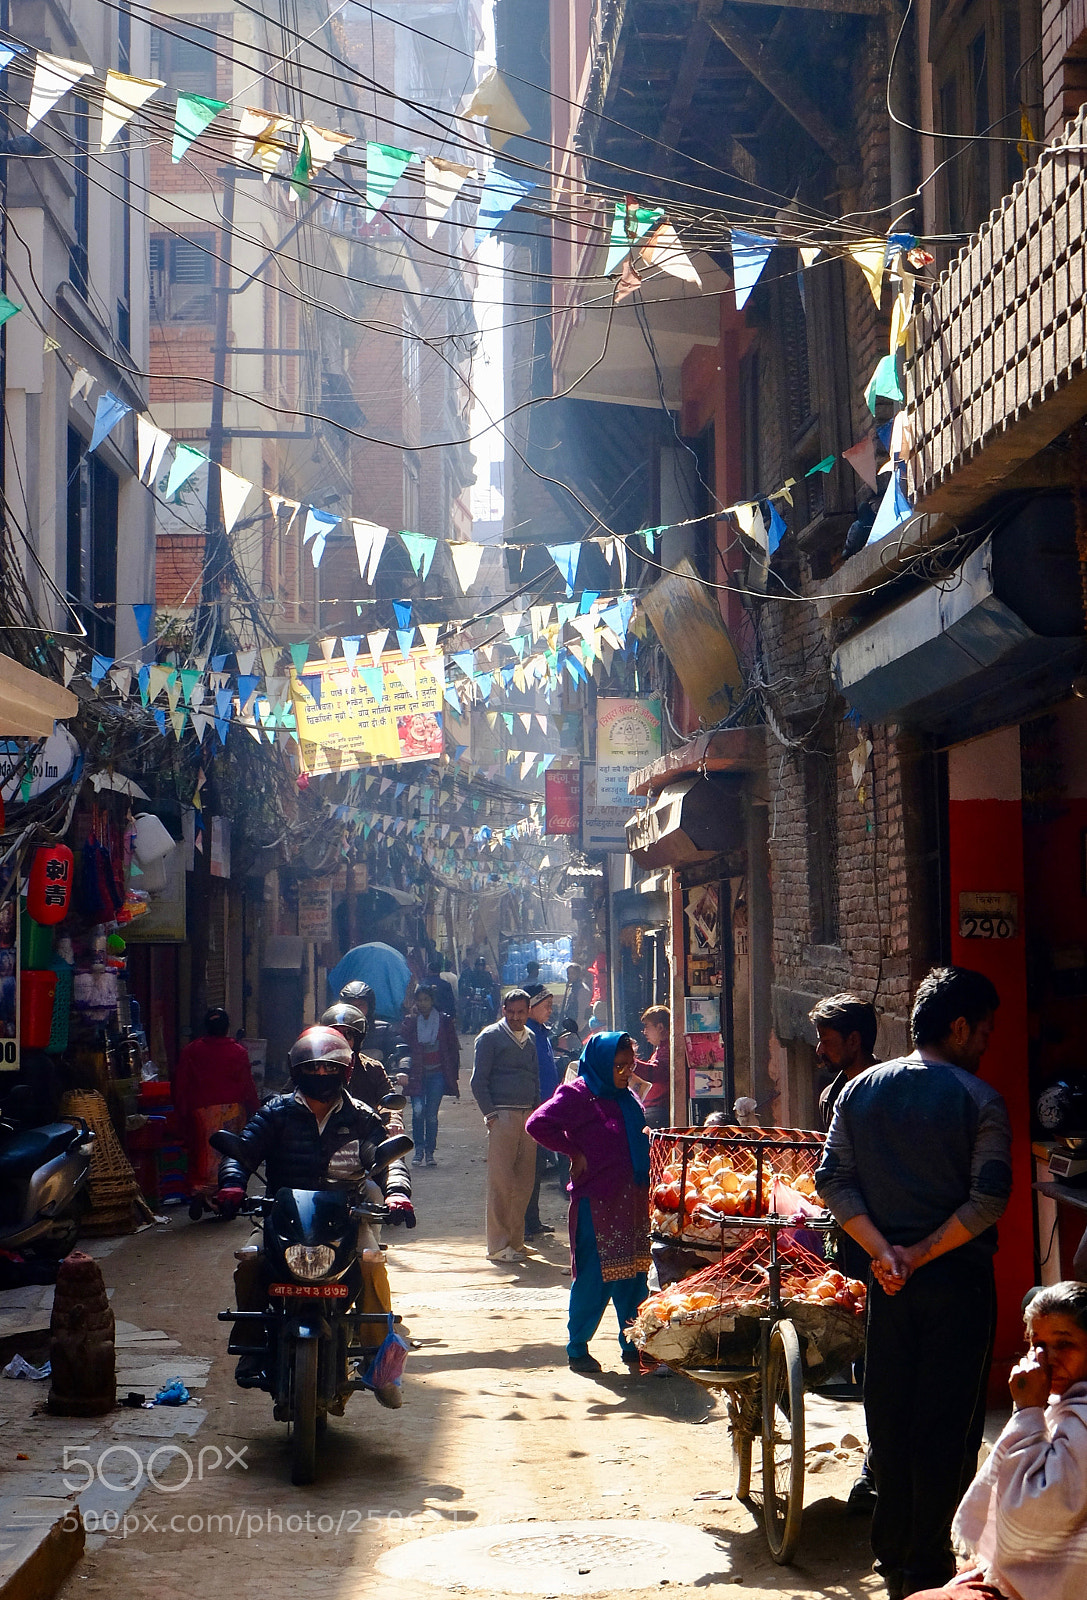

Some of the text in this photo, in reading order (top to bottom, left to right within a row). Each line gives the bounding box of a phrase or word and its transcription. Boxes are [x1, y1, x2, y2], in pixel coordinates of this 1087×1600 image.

[45, 761, 58, 778] Inn
[46, 858, 68, 907] 刺青
[965, 918, 1010, 938] 290
